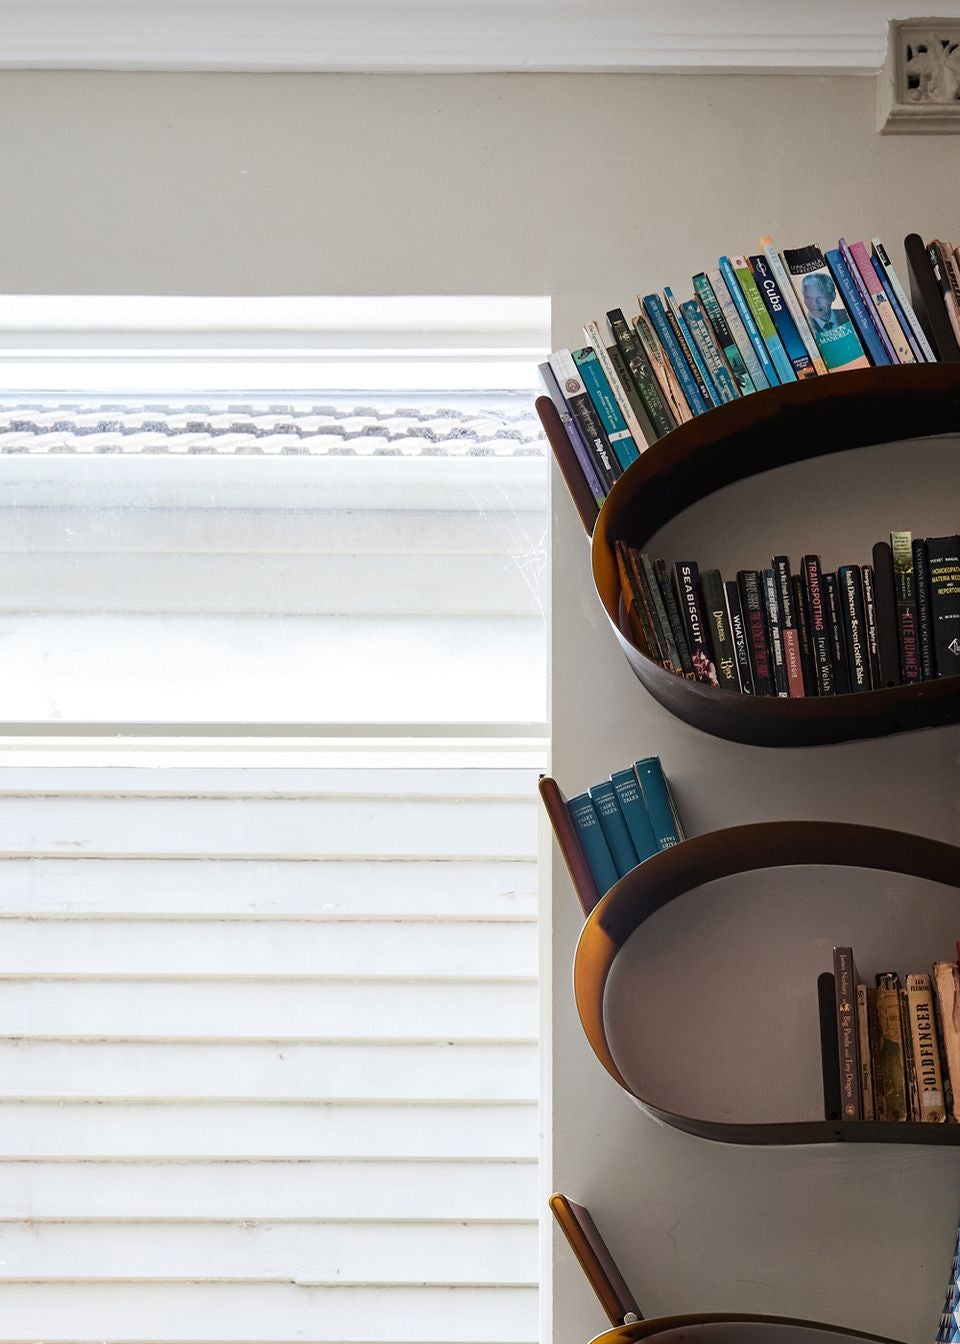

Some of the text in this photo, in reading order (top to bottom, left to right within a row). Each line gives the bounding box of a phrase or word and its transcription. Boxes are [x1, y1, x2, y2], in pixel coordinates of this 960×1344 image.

[762, 278, 783, 312] Cuba
[835, 263, 869, 329] Make This Your Lucky Day
[819, 329, 853, 344] MANDELA
[821, 325, 847, 337] NELSON
[743, 352, 761, 378] ONE
[699, 385, 709, 398] BACH
[680, 565, 703, 644] SEABISCUIT
[808, 560, 823, 631] TRAINSPOTTING
[845, 570, 863, 684] Isak Dinesen Seven Gothic Tales
[902, 613, 917, 677] KITE RUNNER
[788, 647, 797, 678] CARNEGIE
[817, 636, 831, 691] Irvine Welsh
[842, 1016, 850, 1026] Big
[842, 1028, 851, 1046] Panda
[844, 1058, 852, 1071] Tiny
[845, 1073, 853, 1096] Dragon
